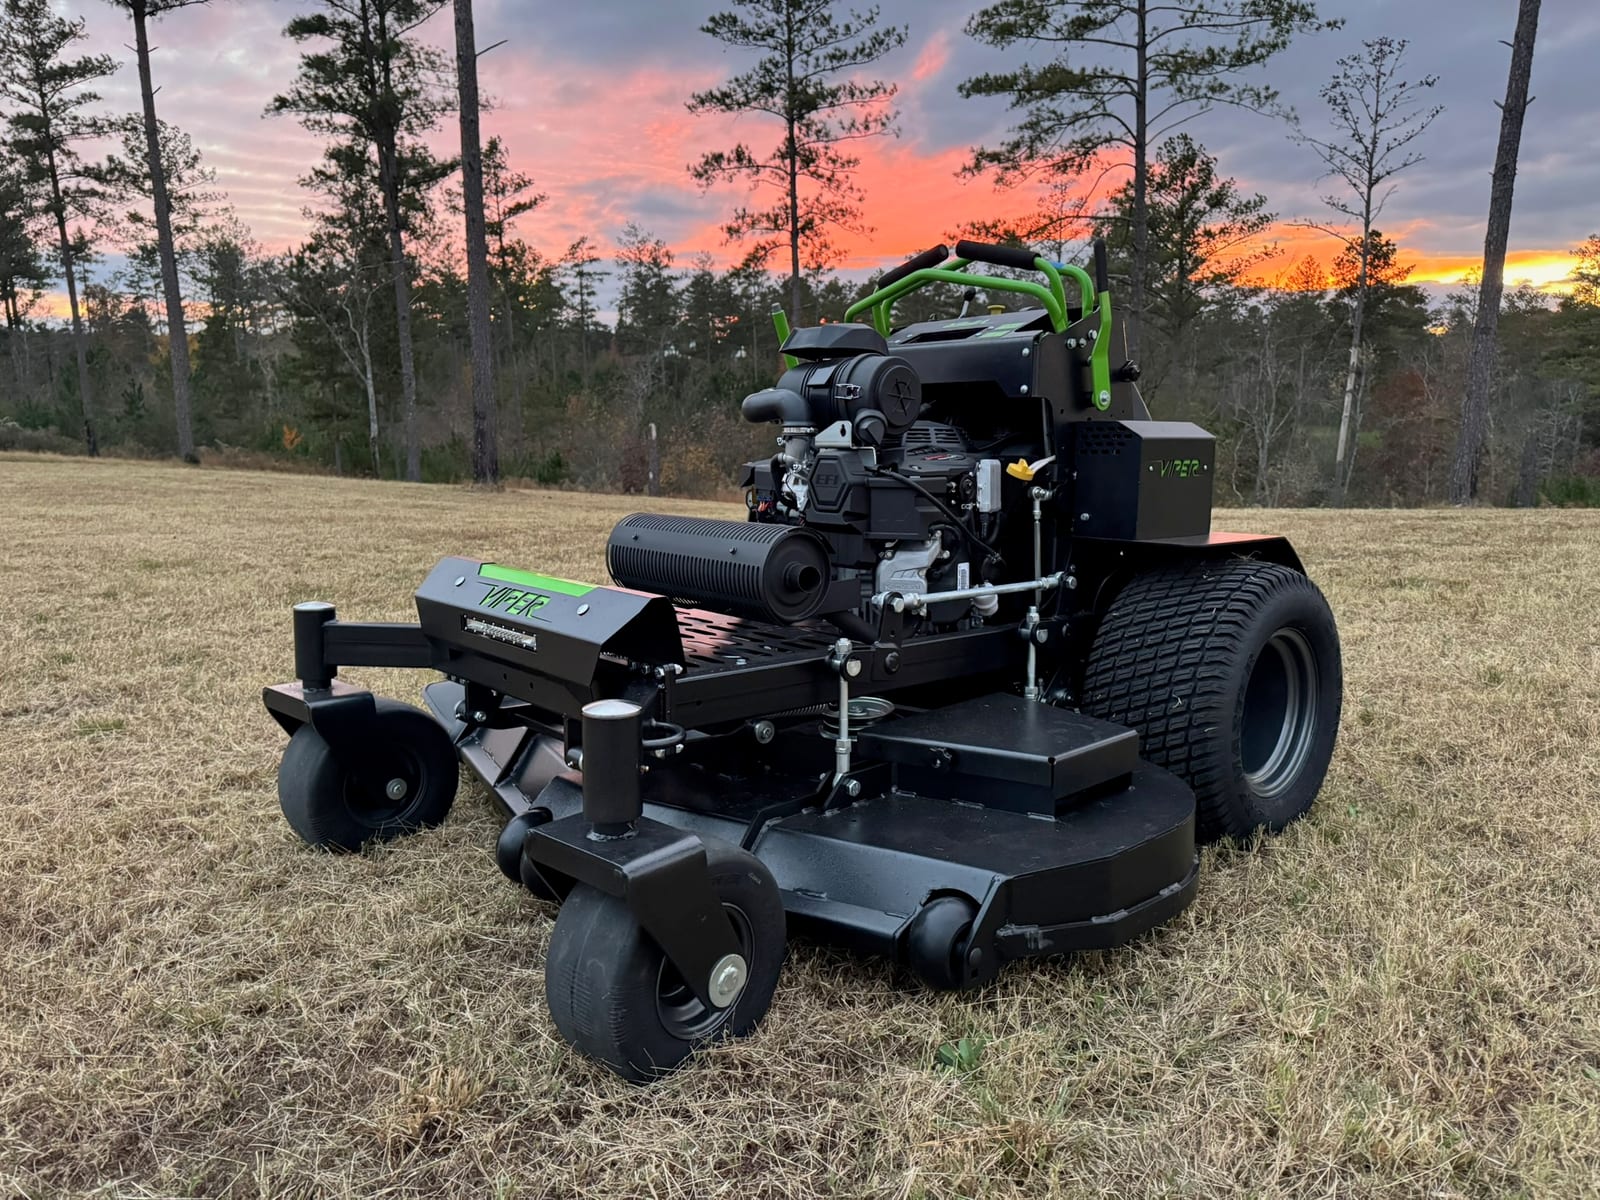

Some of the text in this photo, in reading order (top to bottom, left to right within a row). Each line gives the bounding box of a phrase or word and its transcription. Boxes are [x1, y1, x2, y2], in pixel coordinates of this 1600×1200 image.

[1155, 459, 1202, 478] VIPER
[815, 473, 839, 486] EFI
[478, 582, 552, 622] VIPER
